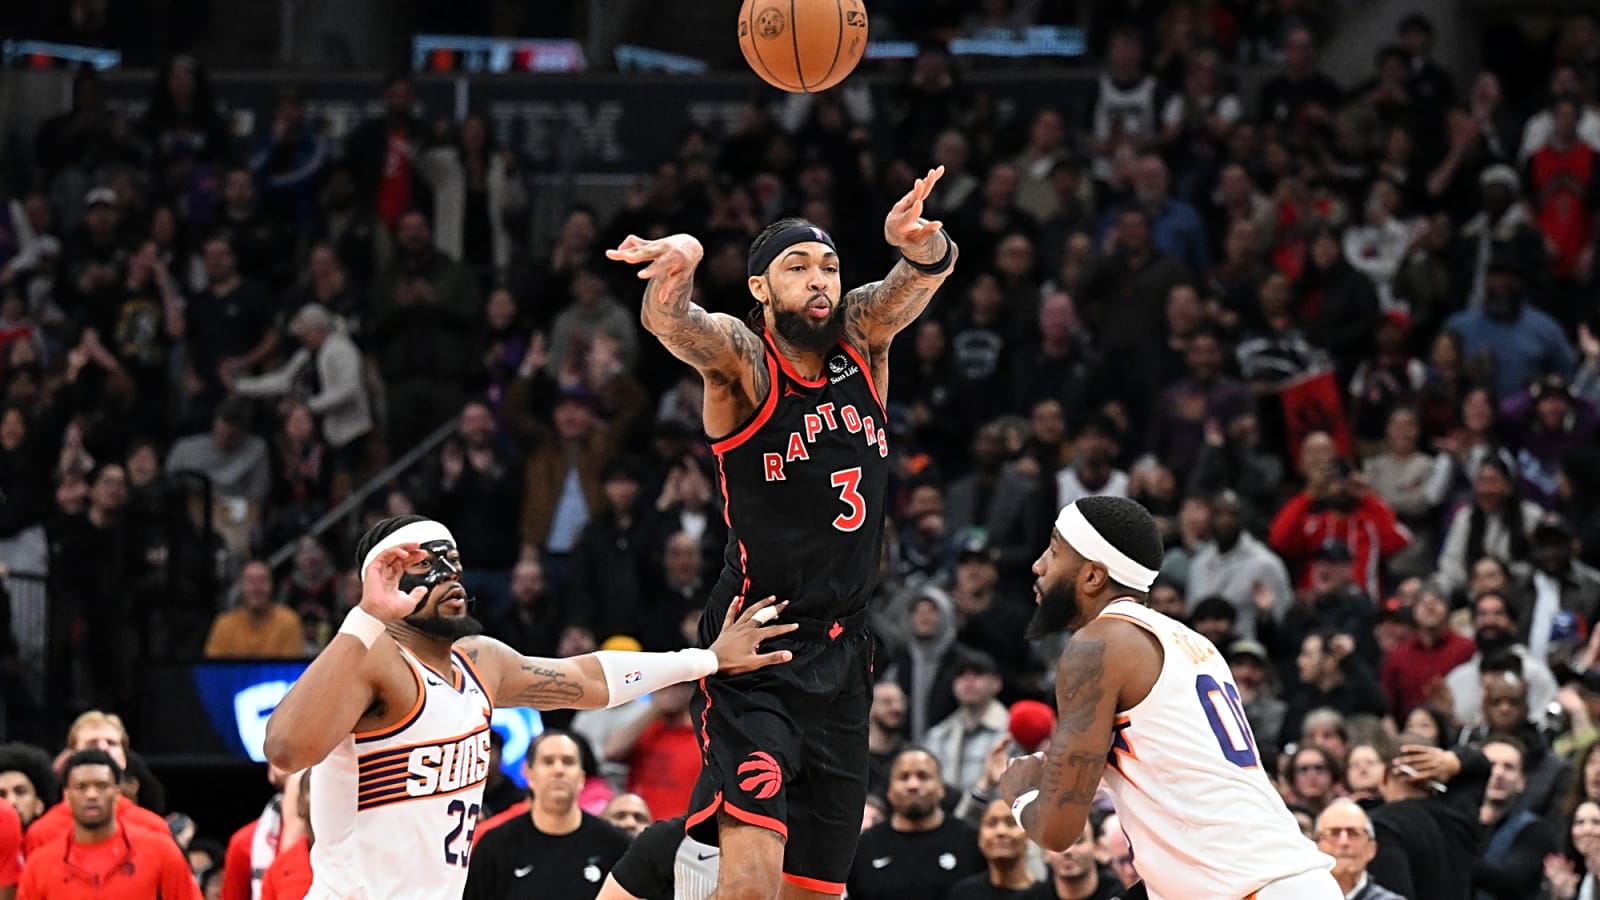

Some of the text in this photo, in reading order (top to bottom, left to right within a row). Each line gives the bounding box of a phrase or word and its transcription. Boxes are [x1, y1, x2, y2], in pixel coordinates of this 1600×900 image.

[830, 365, 859, 385] Sun Life
[763, 402, 888, 482] RAPTORS
[830, 466, 867, 533] 3
[405, 731, 491, 797] SUNS
